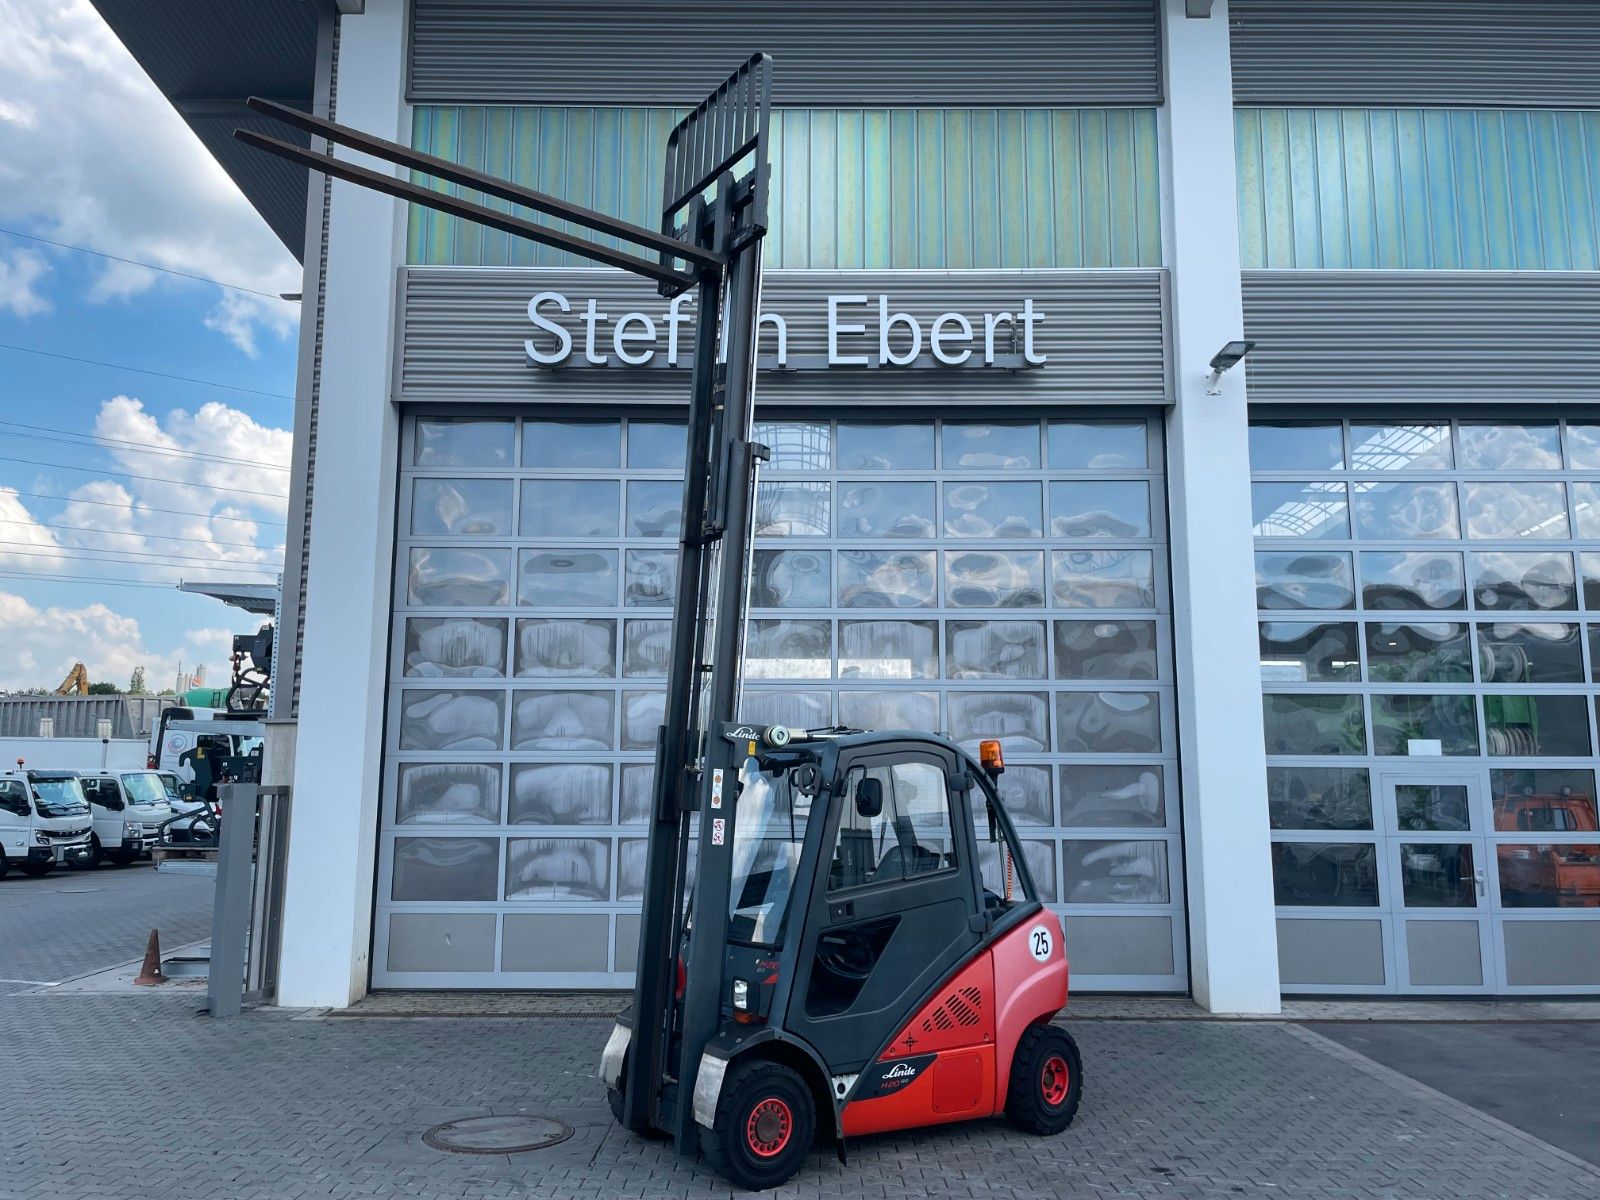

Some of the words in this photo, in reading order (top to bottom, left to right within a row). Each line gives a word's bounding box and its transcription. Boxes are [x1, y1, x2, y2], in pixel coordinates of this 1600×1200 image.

[524, 291, 786, 364] Stefn
[828, 294, 1047, 365] Ebert
[726, 726, 760, 740] Linde
[1033, 931, 1049, 956] 25
[882, 1063, 915, 1079] Linde
